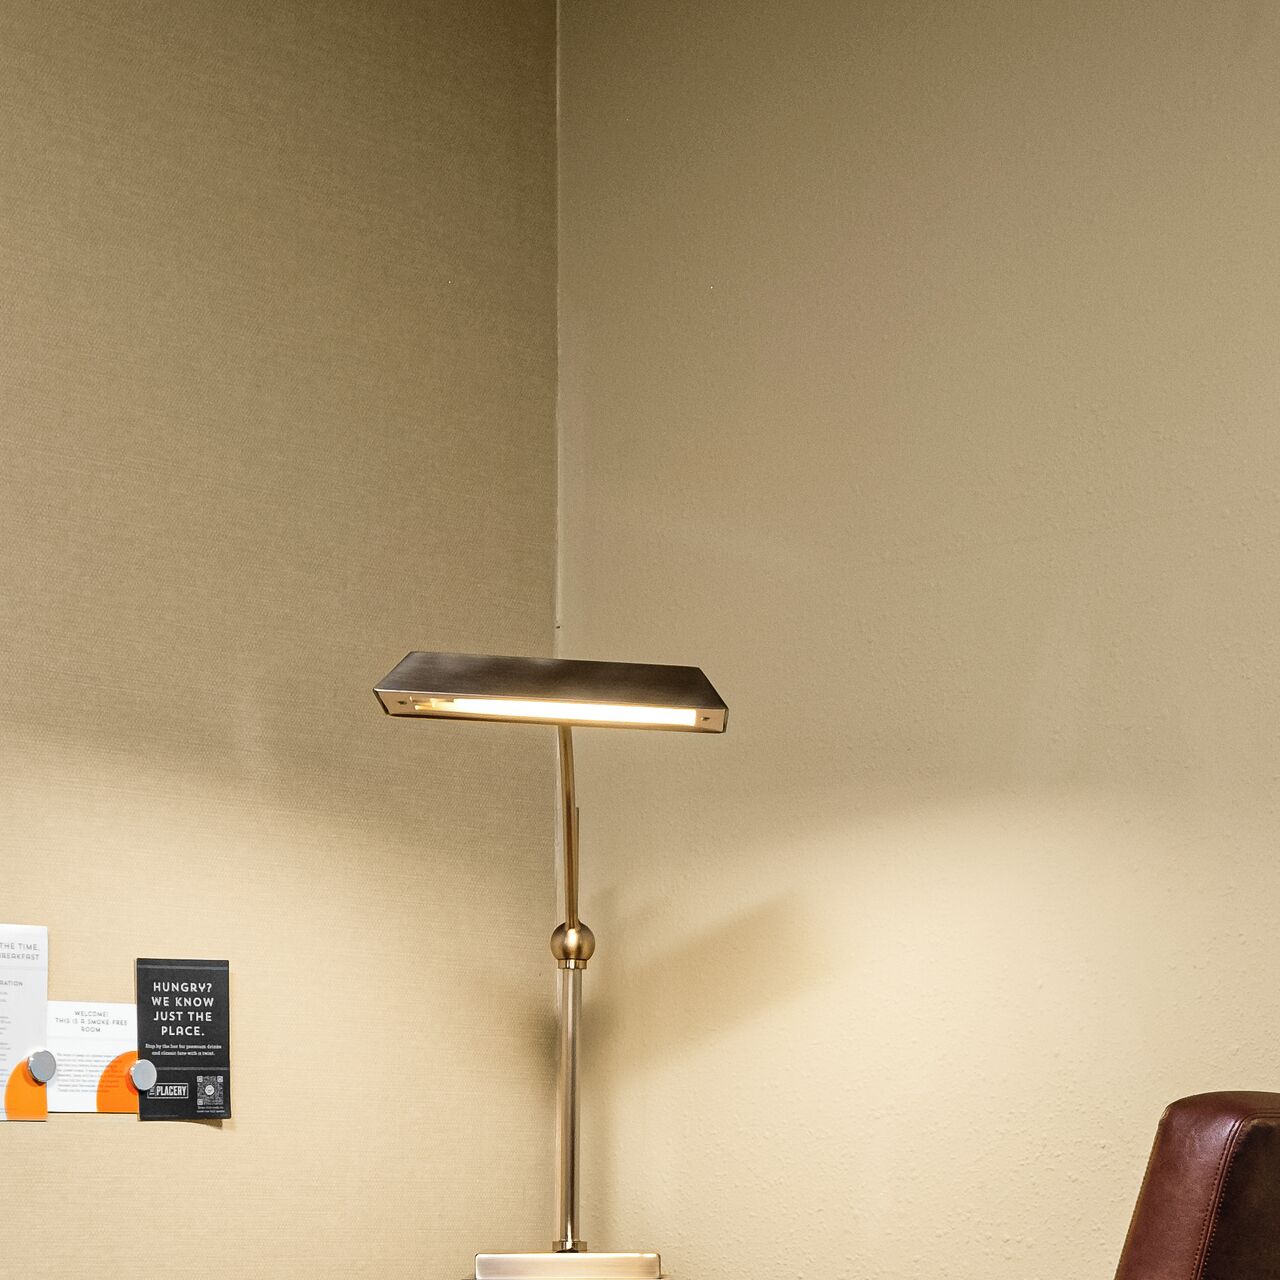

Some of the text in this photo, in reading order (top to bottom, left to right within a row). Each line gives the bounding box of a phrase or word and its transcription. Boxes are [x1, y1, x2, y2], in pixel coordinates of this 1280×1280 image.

[0, 942, 15, 950] THE
[153, 981, 212, 993] HUNGRY?
[151, 996, 214, 1007] WE KNOW
[87, 1018, 110, 1026] SMOKE
[153, 1011, 213, 1022] JUST THE
[161, 1025, 205, 1036] PLACE.
[156, 1085, 187, 1096] PLACERY
